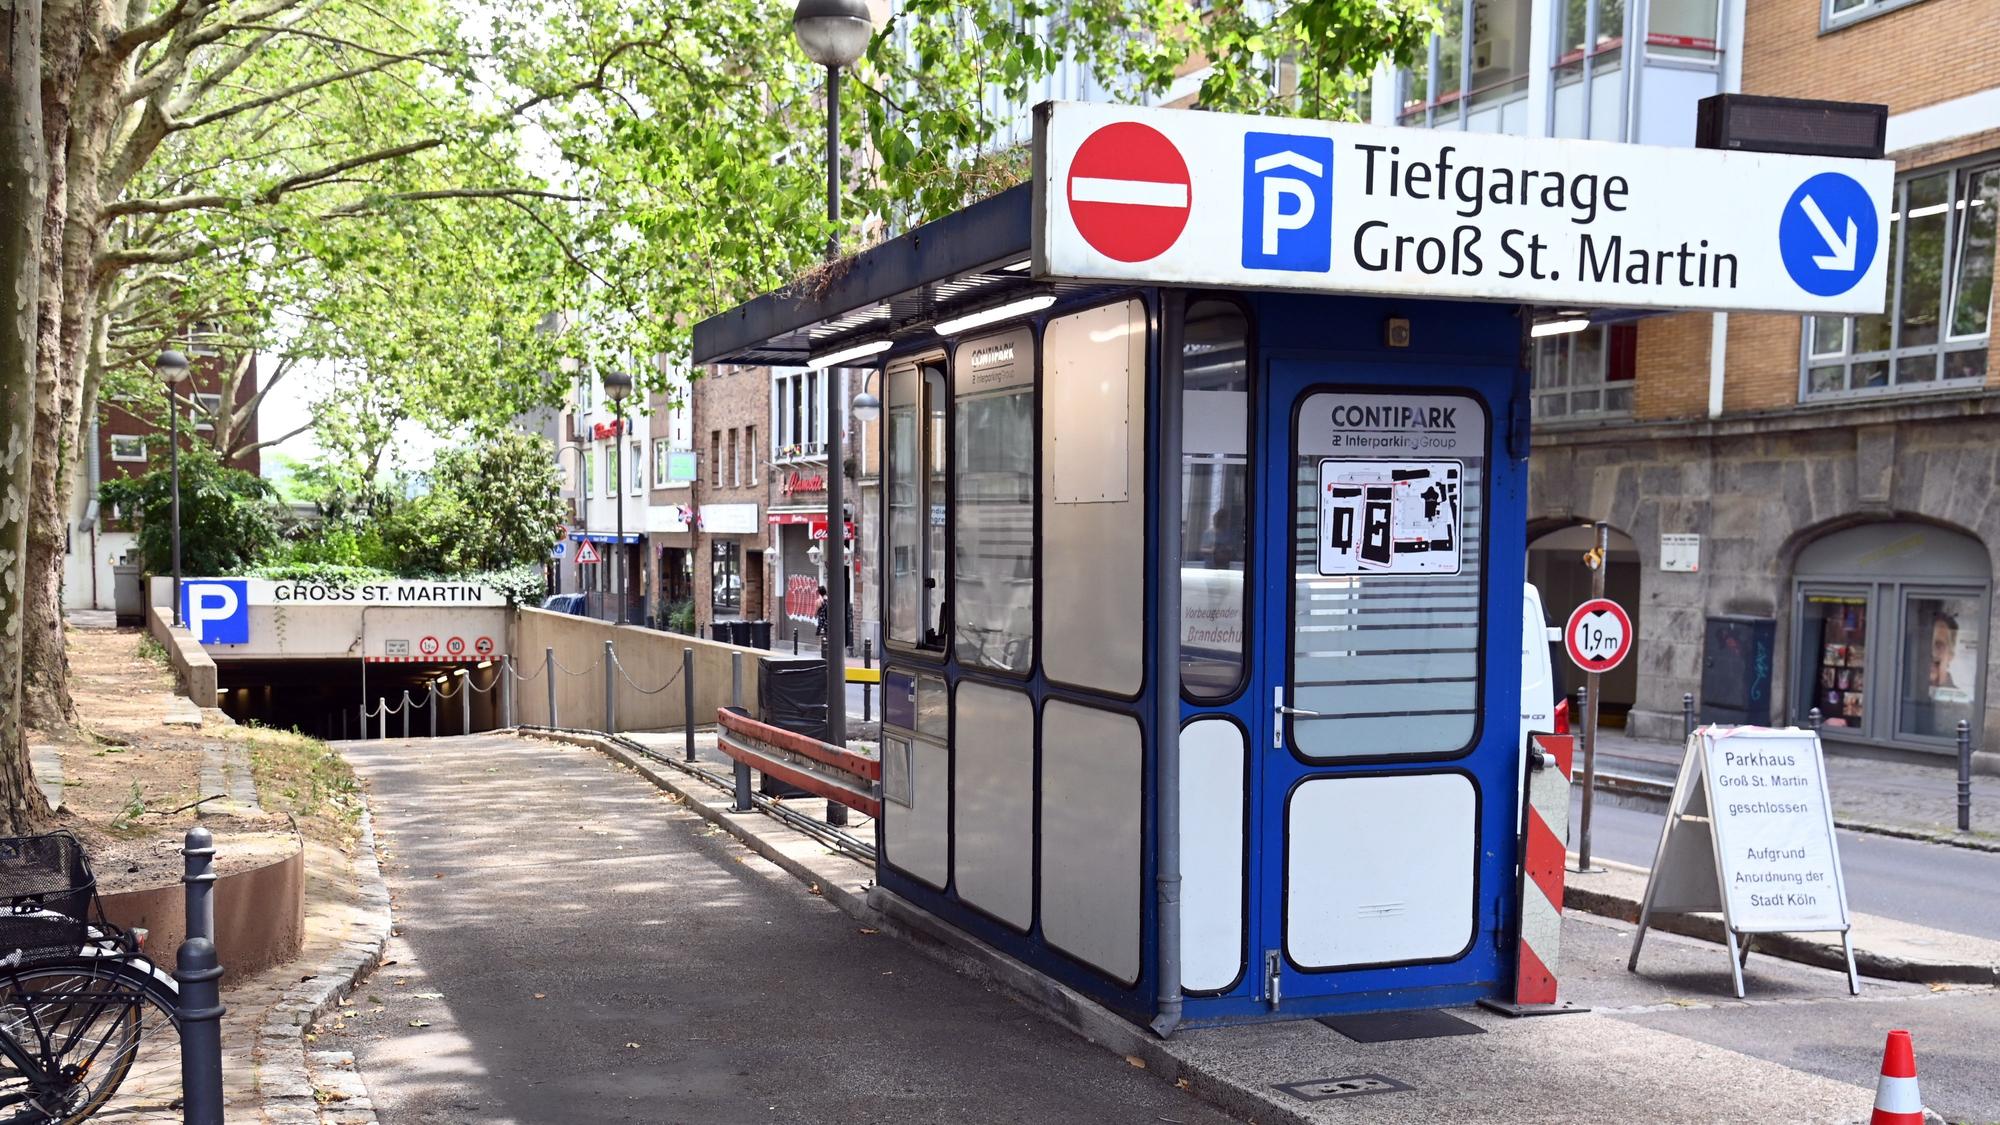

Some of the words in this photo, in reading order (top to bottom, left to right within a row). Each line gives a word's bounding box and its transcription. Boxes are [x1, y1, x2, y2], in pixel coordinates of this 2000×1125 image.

[1354, 143, 1629, 225] Tiefgarage
[1262, 176, 1315, 256] P
[1353, 220, 1484, 277] Groß
[1498, 228, 1560, 281] St.
[1578, 233, 1738, 289] Martin
[1331, 405, 1457, 429] CONTIPARK
[275, 585, 355, 601] GROSS
[362, 585, 390, 601] ST.
[398, 586, 482, 601] MARTIN
[188, 584, 239, 641] P
[1185, 607, 1239, 622] Vorbeugender
[1582, 622, 1603, 652] 1,9
[452, 641, 460, 651] 10
[1725, 752, 1796, 766] Parkhaus
[1719, 775, 1749, 787] Groß
[1752, 775, 1768, 787] St.
[1771, 775, 1808, 787] Martin
[1729, 802, 1808, 817] geschlossen
[1747, 847, 1806, 862] Aufgrund
[1735, 871, 1803, 885] Anordnung
[1806, 870, 1824, 881] der
[1750, 894, 1785, 907] Stadt
[1787, 893, 1817, 906] Köln
